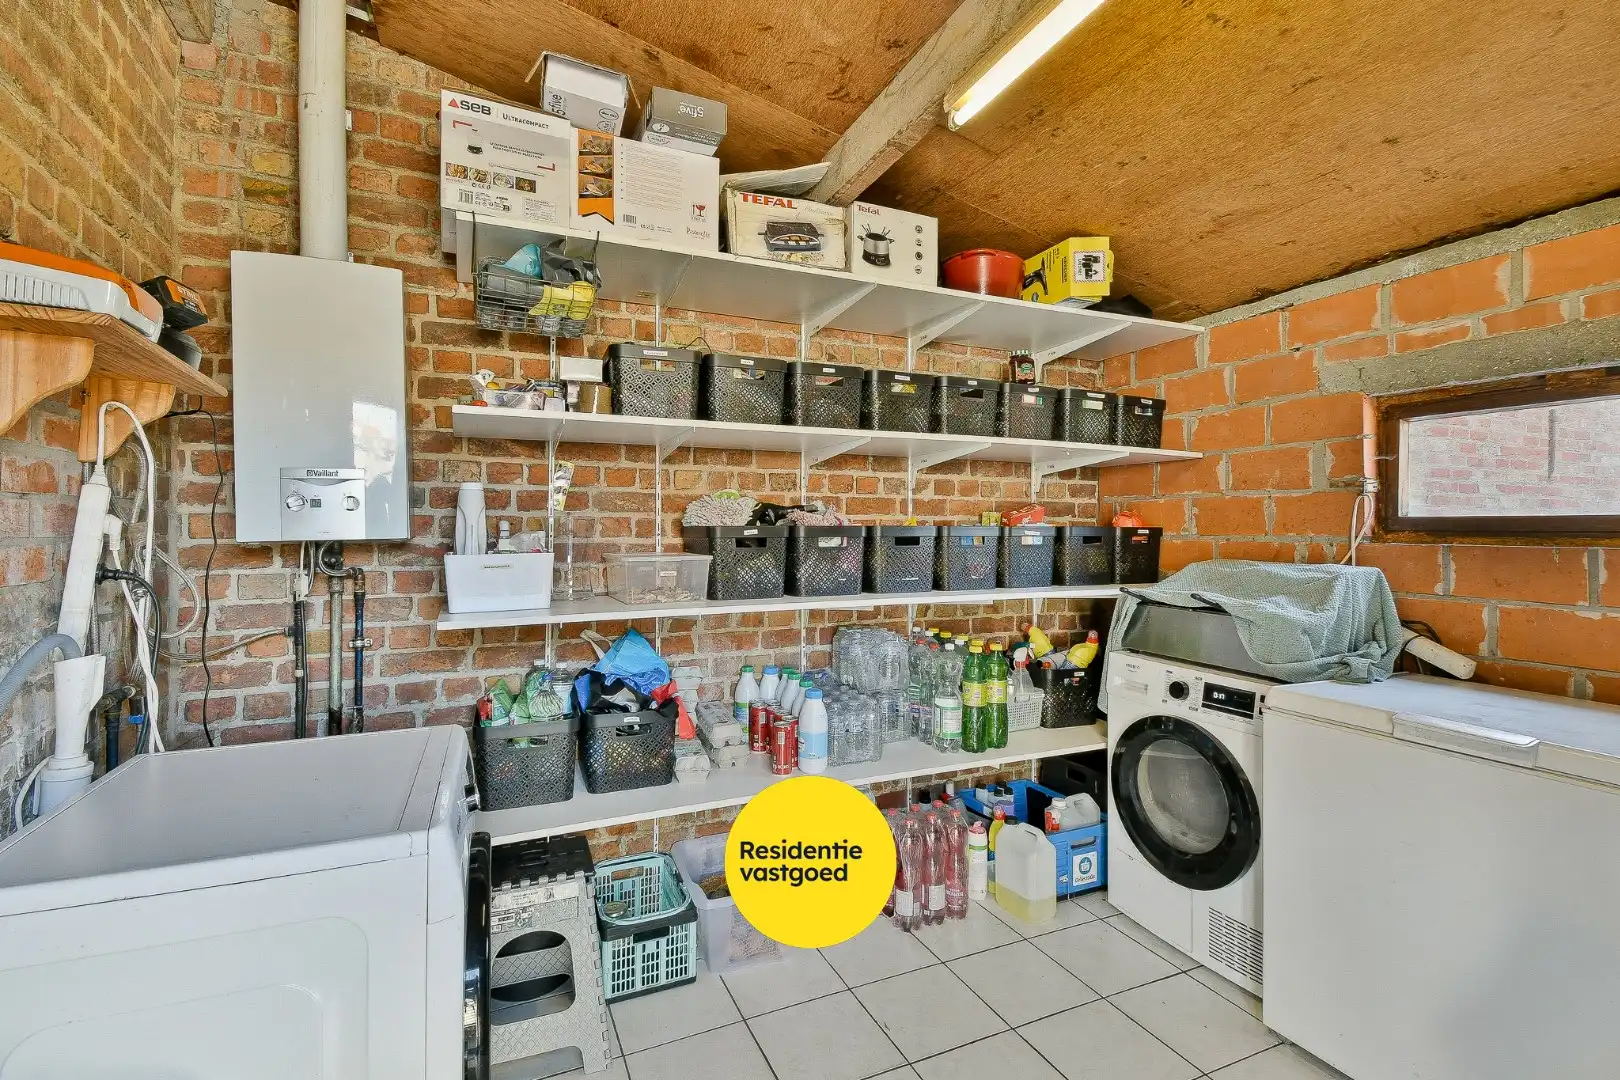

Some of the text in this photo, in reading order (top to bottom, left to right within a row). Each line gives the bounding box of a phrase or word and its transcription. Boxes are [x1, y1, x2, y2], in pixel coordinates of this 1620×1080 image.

[680, 105, 704, 118] 5five
[739, 192, 797, 209] TEFAL
[857, 204, 881, 215] Tefal
[313, 469, 339, 477] Vaillant
